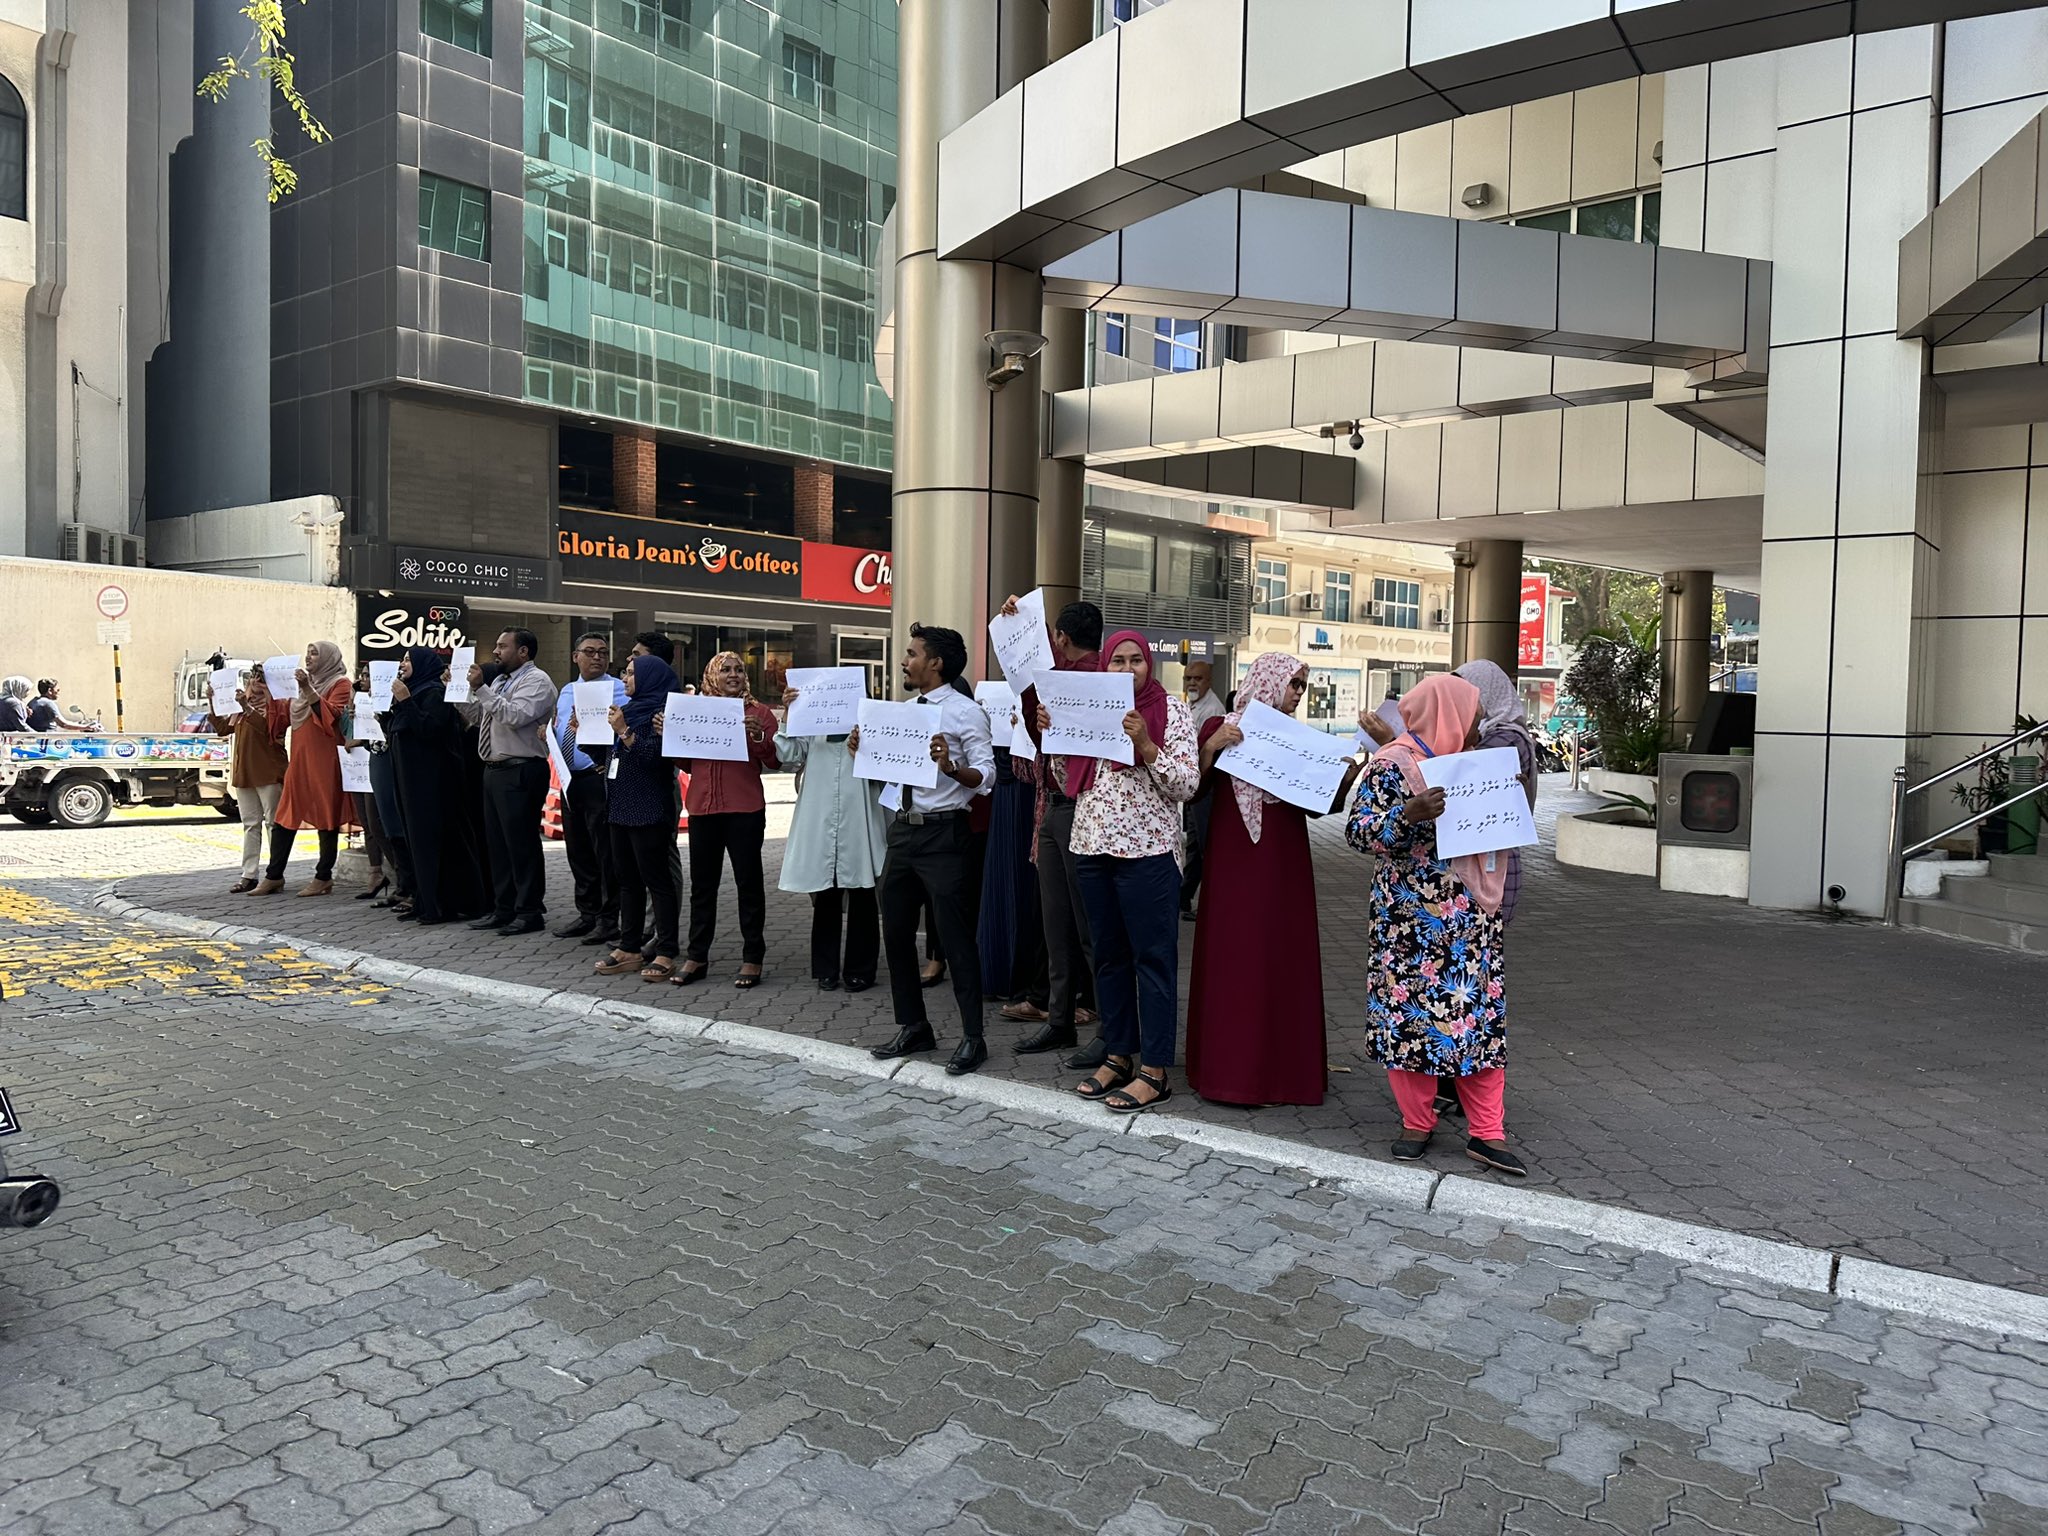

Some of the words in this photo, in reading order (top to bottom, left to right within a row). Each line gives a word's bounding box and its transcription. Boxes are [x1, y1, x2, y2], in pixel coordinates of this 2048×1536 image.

[558, 531, 630, 560] Gloria
[635, 539, 696, 566] Jean's
[729, 550, 799, 575] Coffees
[425, 560, 468, 574] COCO
[474, 564, 509, 578] CHIC
[360, 608, 466, 648] Solite
[430, 609, 460, 622] open
